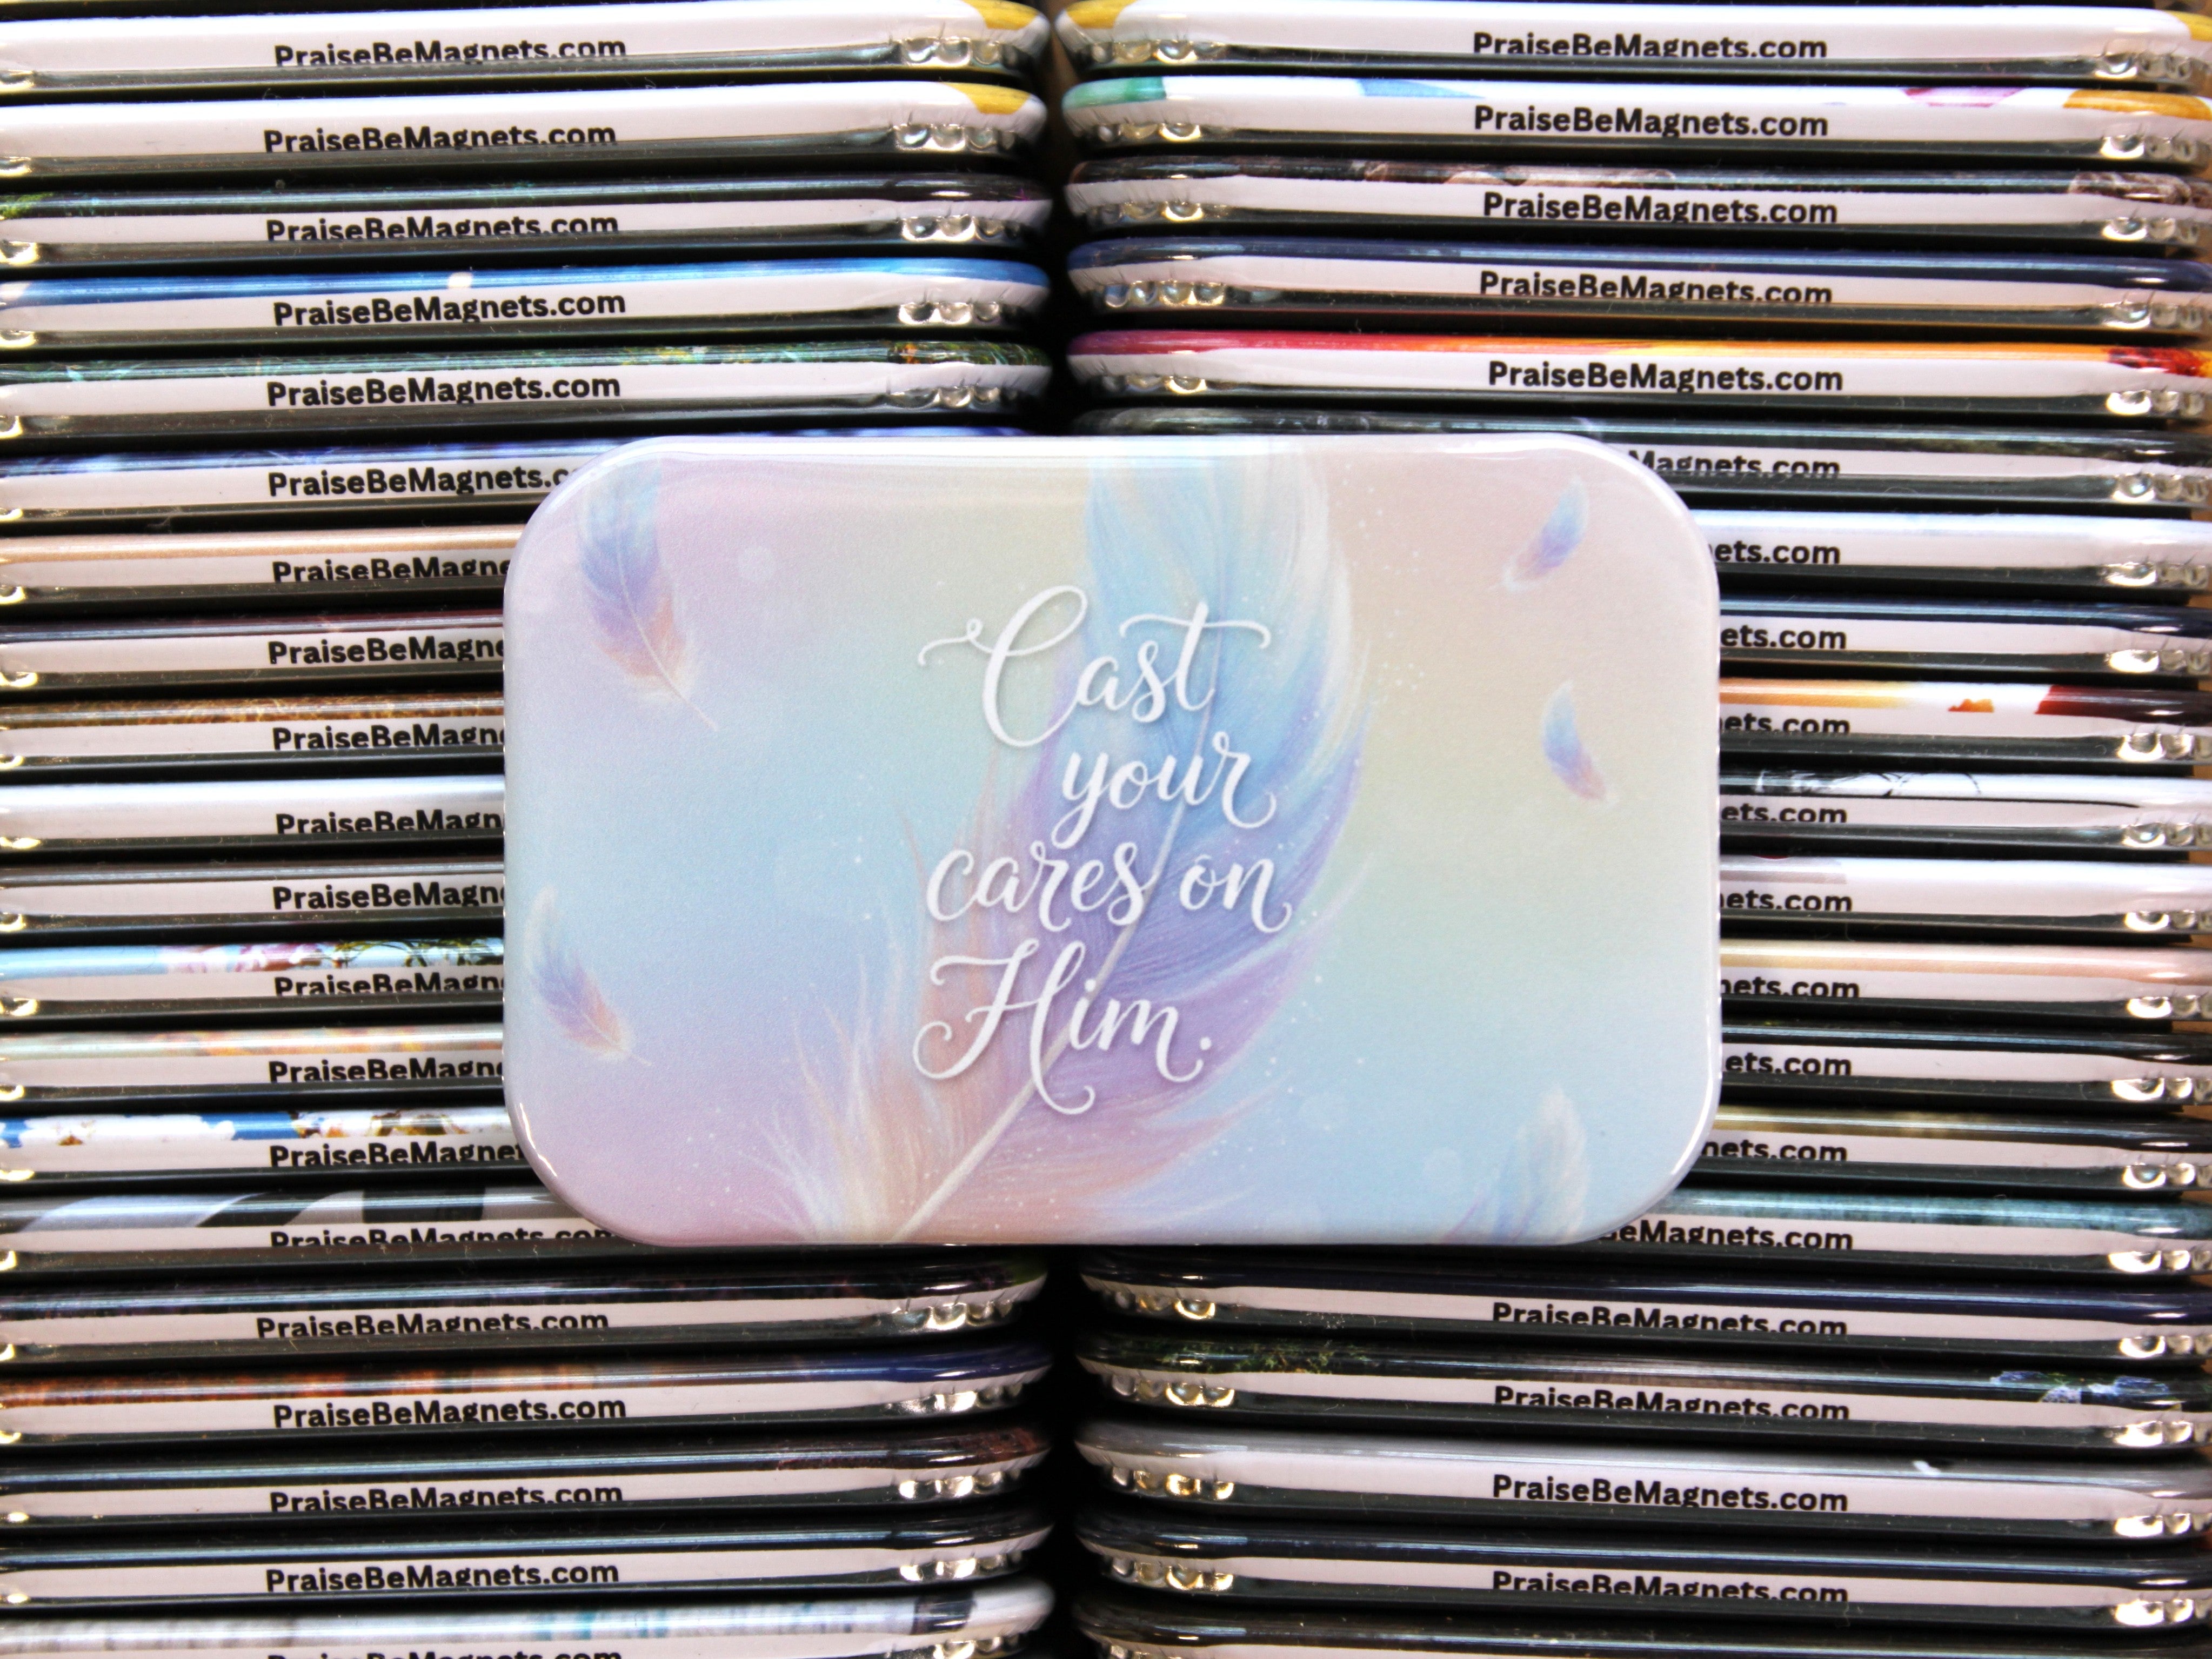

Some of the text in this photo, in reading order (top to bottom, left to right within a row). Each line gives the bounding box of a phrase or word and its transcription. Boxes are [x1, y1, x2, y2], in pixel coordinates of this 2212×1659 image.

[1474, 31, 1827, 59] PraiseBeMagnets.com
[1475, 105, 1827, 137] PraiseBeMagnets.com
[265, 126, 616, 151] PraiseBeMagnets.com
[1484, 191, 1837, 223] PraiseBeMagnets.com
[1480, 271, 1833, 303] PraiseBeMagnets.com
[274, 295, 625, 325] PraiseBeMagnets.com
[268, 376, 620, 406] PraiseBeMagnets.com
[1489, 360, 1842, 393] PraiseBeMagnets.com
[269, 467, 578, 496] PraiseBeMagnets.c
[918, 585, 1271, 747] Cast
[273, 723, 504, 750] PraiseBeMagn
[1051, 731, 1277, 850] your
[273, 882, 503, 910] PraiseBeMagn
[927, 841, 1292, 933] cares on
[275, 973, 503, 996] PraiseBeMagn
[913, 938, 1212, 1114] Him.
[257, 1314, 609, 1337] PraiseBeMagnets.com
[274, 1400, 625, 1427] PraiseBeMagnets.com
[270, 1487, 623, 1512] PraiseBeMagnets.com
[1493, 1475, 1848, 1511] PraiseBeMagnets.com
[266, 1565, 619, 1591] PraiseBeMagnets.com
